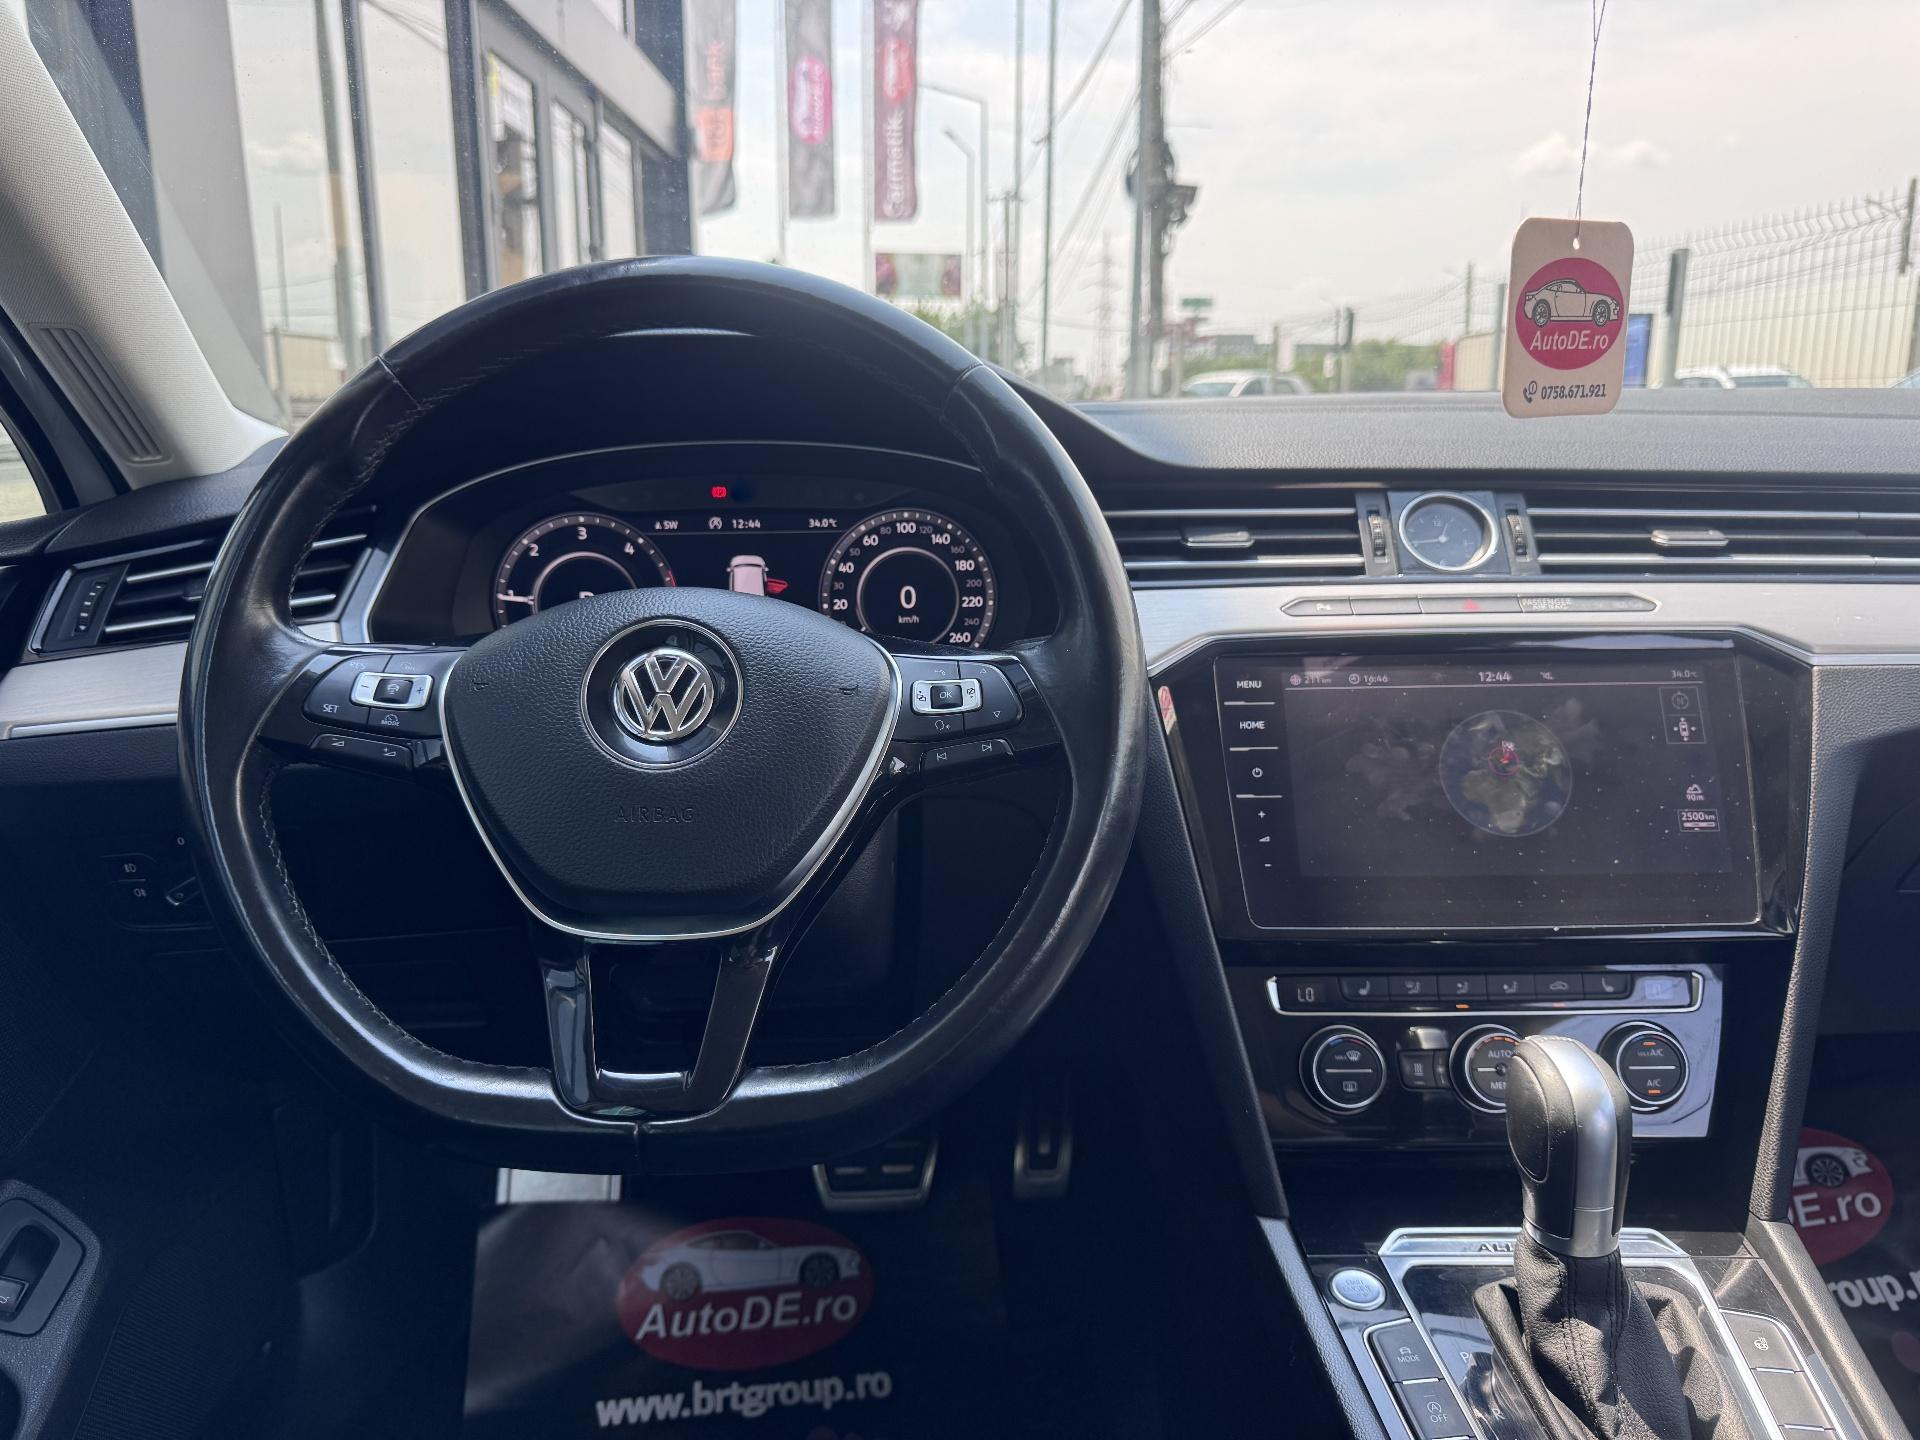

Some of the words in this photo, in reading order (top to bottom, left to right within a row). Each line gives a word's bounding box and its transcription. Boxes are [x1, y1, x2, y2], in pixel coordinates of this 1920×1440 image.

[1530, 330, 1609, 351] AutoDE.ro
[1541, 384, 1607, 400] 0758.671.921
[664, 520, 679, 530] SW
[732, 519, 761, 529] 12:44
[895, 522, 917, 534] 100
[577, 527, 588, 540] 3
[919, 526, 933, 534] 120
[863, 535, 879, 546] 60
[931, 533, 951, 545] 140
[528, 544, 540, 557] 2
[624, 543, 636, 556] 4
[838, 562, 855, 574] 40
[955, 560, 975, 571] 180
[833, 582, 844, 590] 30
[966, 579, 982, 588] 200
[899, 586, 917, 609] 0
[962, 596, 984, 607] 220
[833, 598, 848, 610] 20
[898, 615, 919, 624] km/h
[964, 618, 980, 626] 240
[949, 632, 971, 643] 260
[1478, 672, 1511, 682] 12:44
[1236, 680, 1262, 689] MENU
[939, 691, 953, 699] OK
[323, 704, 340, 713] SET
[1239, 721, 1265, 729] HOME
[614, 806, 695, 823] AIRBAG
[1788, 1191, 1882, 1228] E.ro
[634, 1292, 858, 1340] AutoDE.ro
[1397, 1354, 1420, 1363] MODE
[596, 1371, 893, 1427] www.brtgroup.ro
[1430, 1413, 1448, 1423] OFF
[1491, 1408, 1506, 1420] R
